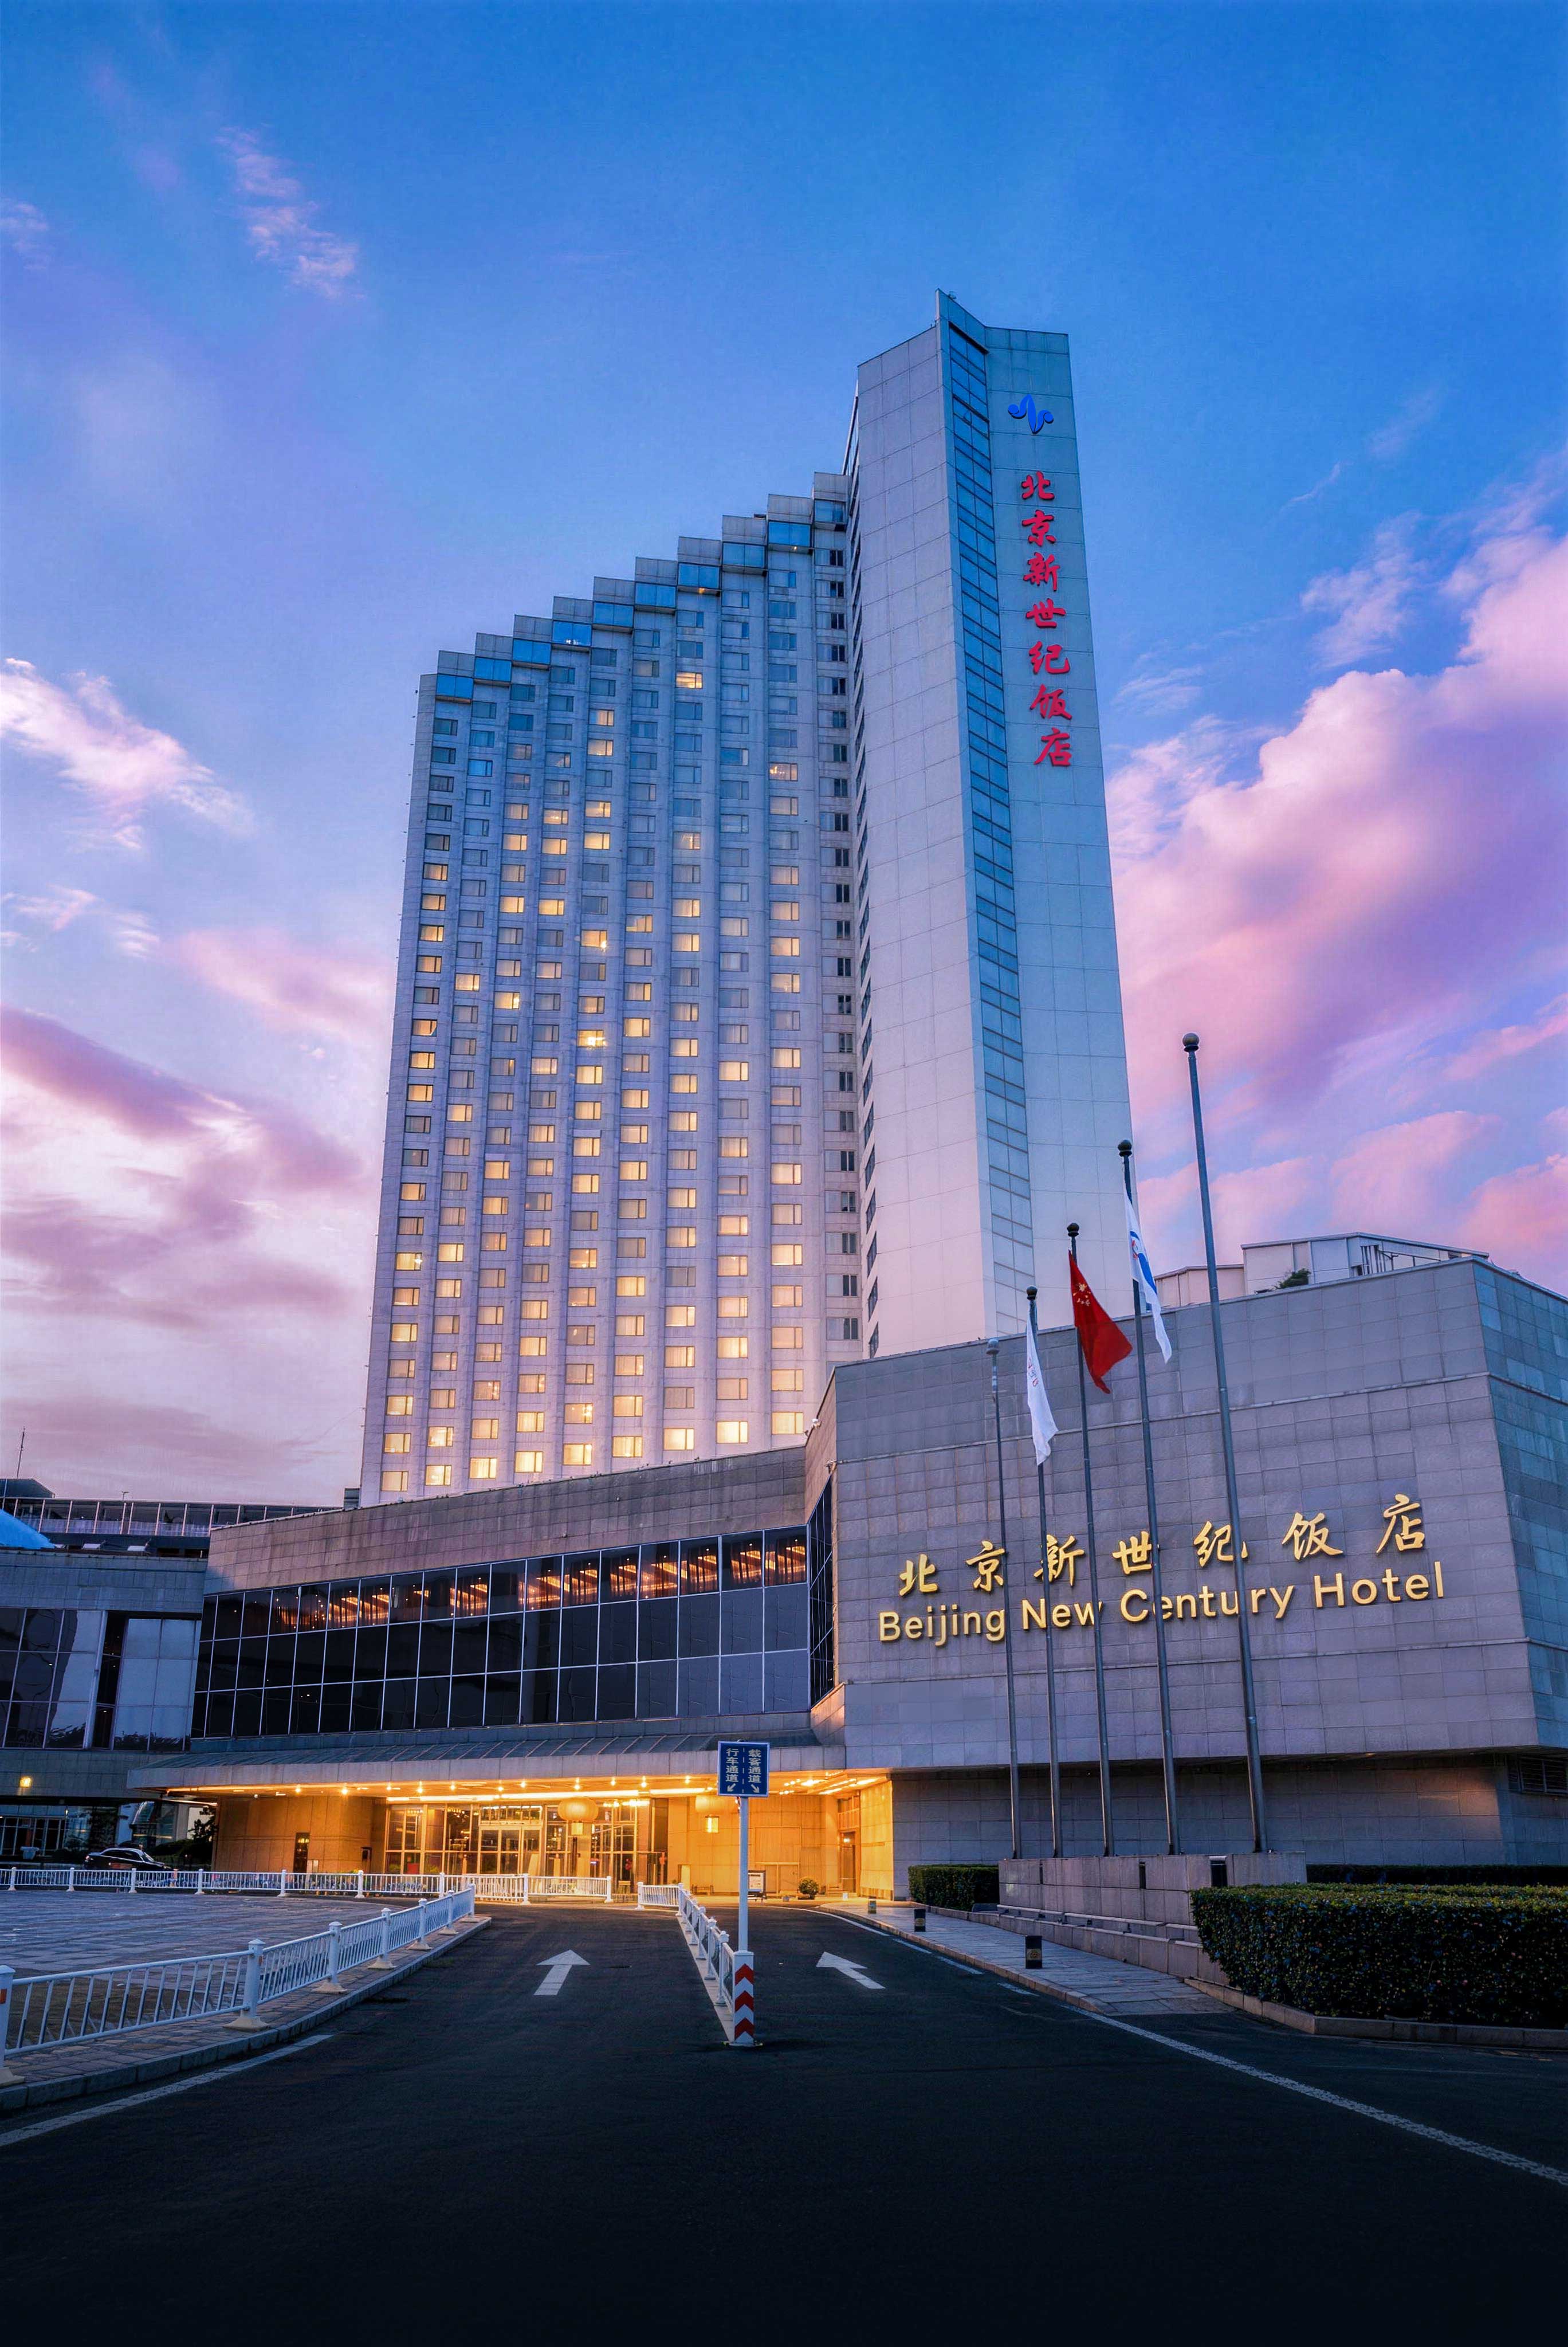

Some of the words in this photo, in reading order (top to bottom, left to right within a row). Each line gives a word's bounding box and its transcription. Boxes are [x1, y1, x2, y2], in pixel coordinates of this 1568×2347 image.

[1021, 471, 1072, 767] 北京新世纪饭店
[899, 1493, 1425, 1596] 北京新世纪饭店
[879, 1604, 1006, 1647] Beijing
[1021, 1598, 1103, 1630] New
[1119, 1585, 1295, 1622] Century
[1314, 1561, 1444, 1609] Hotel
[725, 1748, 739, 1783] 行车通道
[748, 1749, 761, 1783] 载客通道
